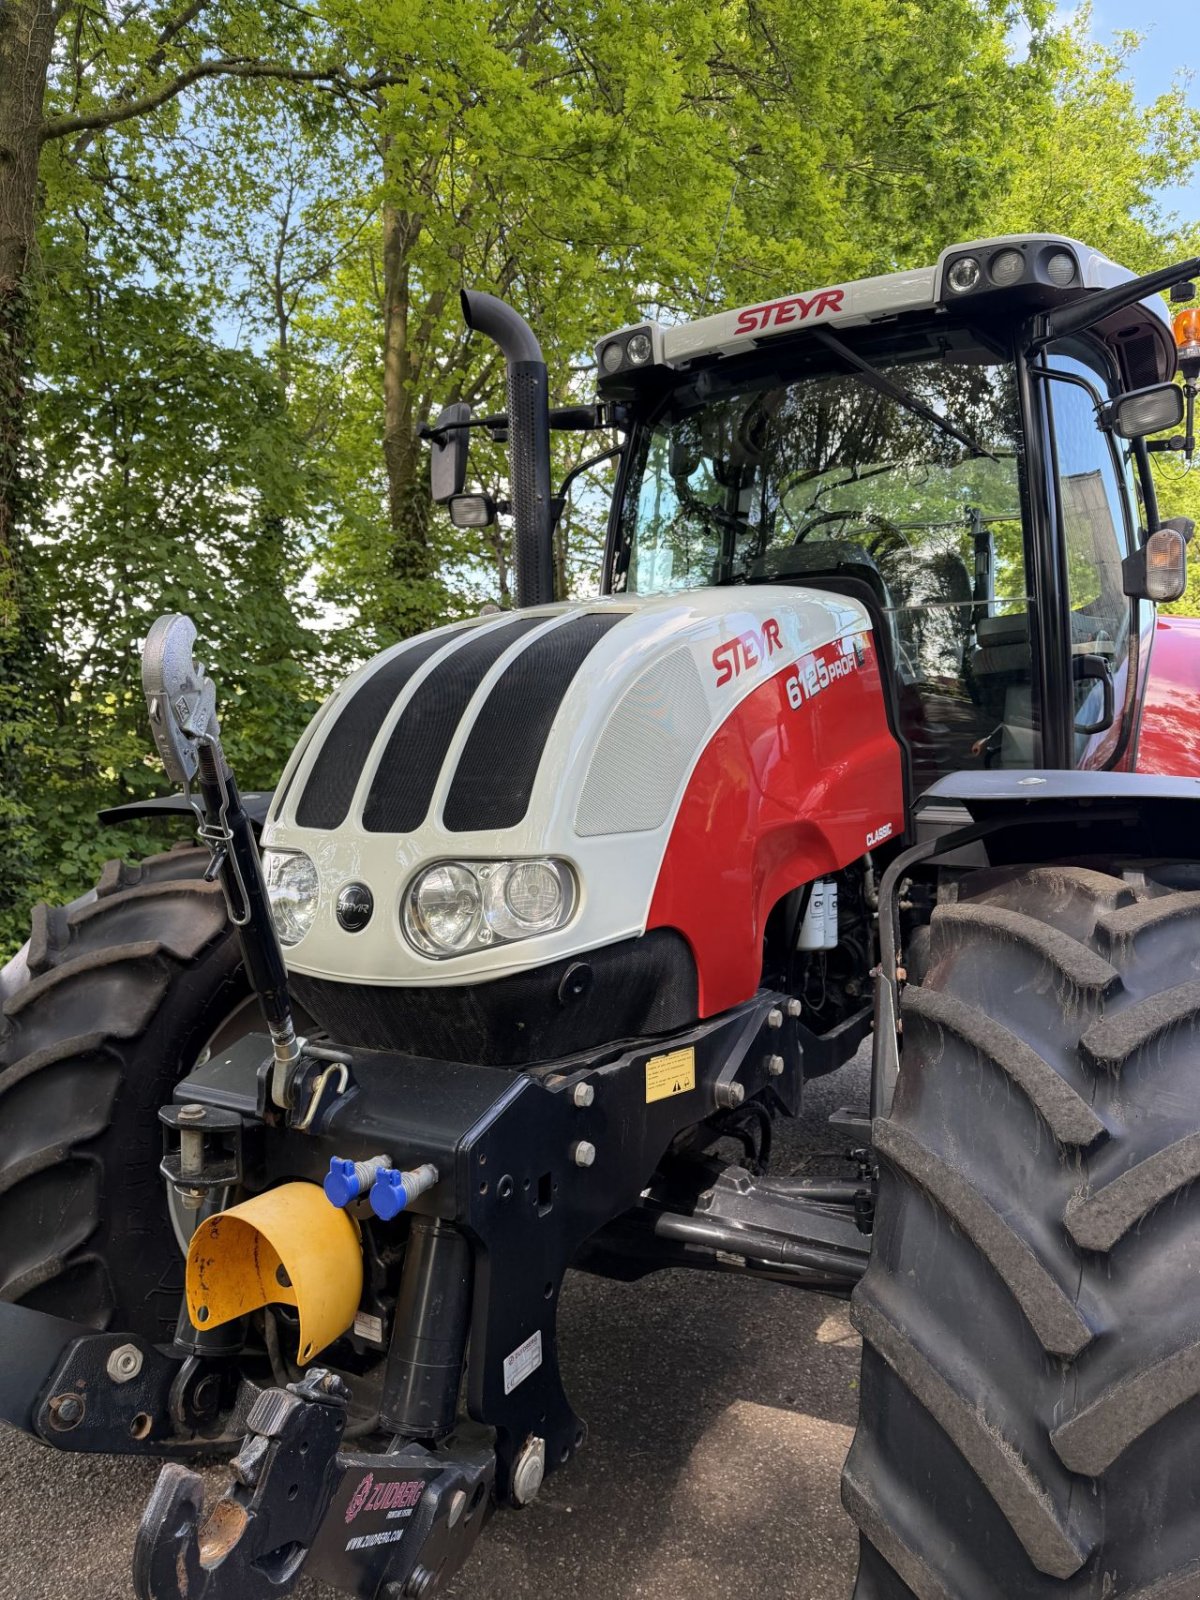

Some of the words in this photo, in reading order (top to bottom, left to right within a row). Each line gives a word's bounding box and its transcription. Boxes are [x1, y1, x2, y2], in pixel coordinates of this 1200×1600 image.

[734, 289, 845, 335] STEYR
[712, 618, 784, 688] STEYR
[785, 657, 830, 710] 6125
[828, 653, 857, 683] PROFI
[866, 822, 893, 847] CLASSIC
[336, 901, 369, 914] STEYR
[363, 1480, 426, 1511] ZUIDBERG
